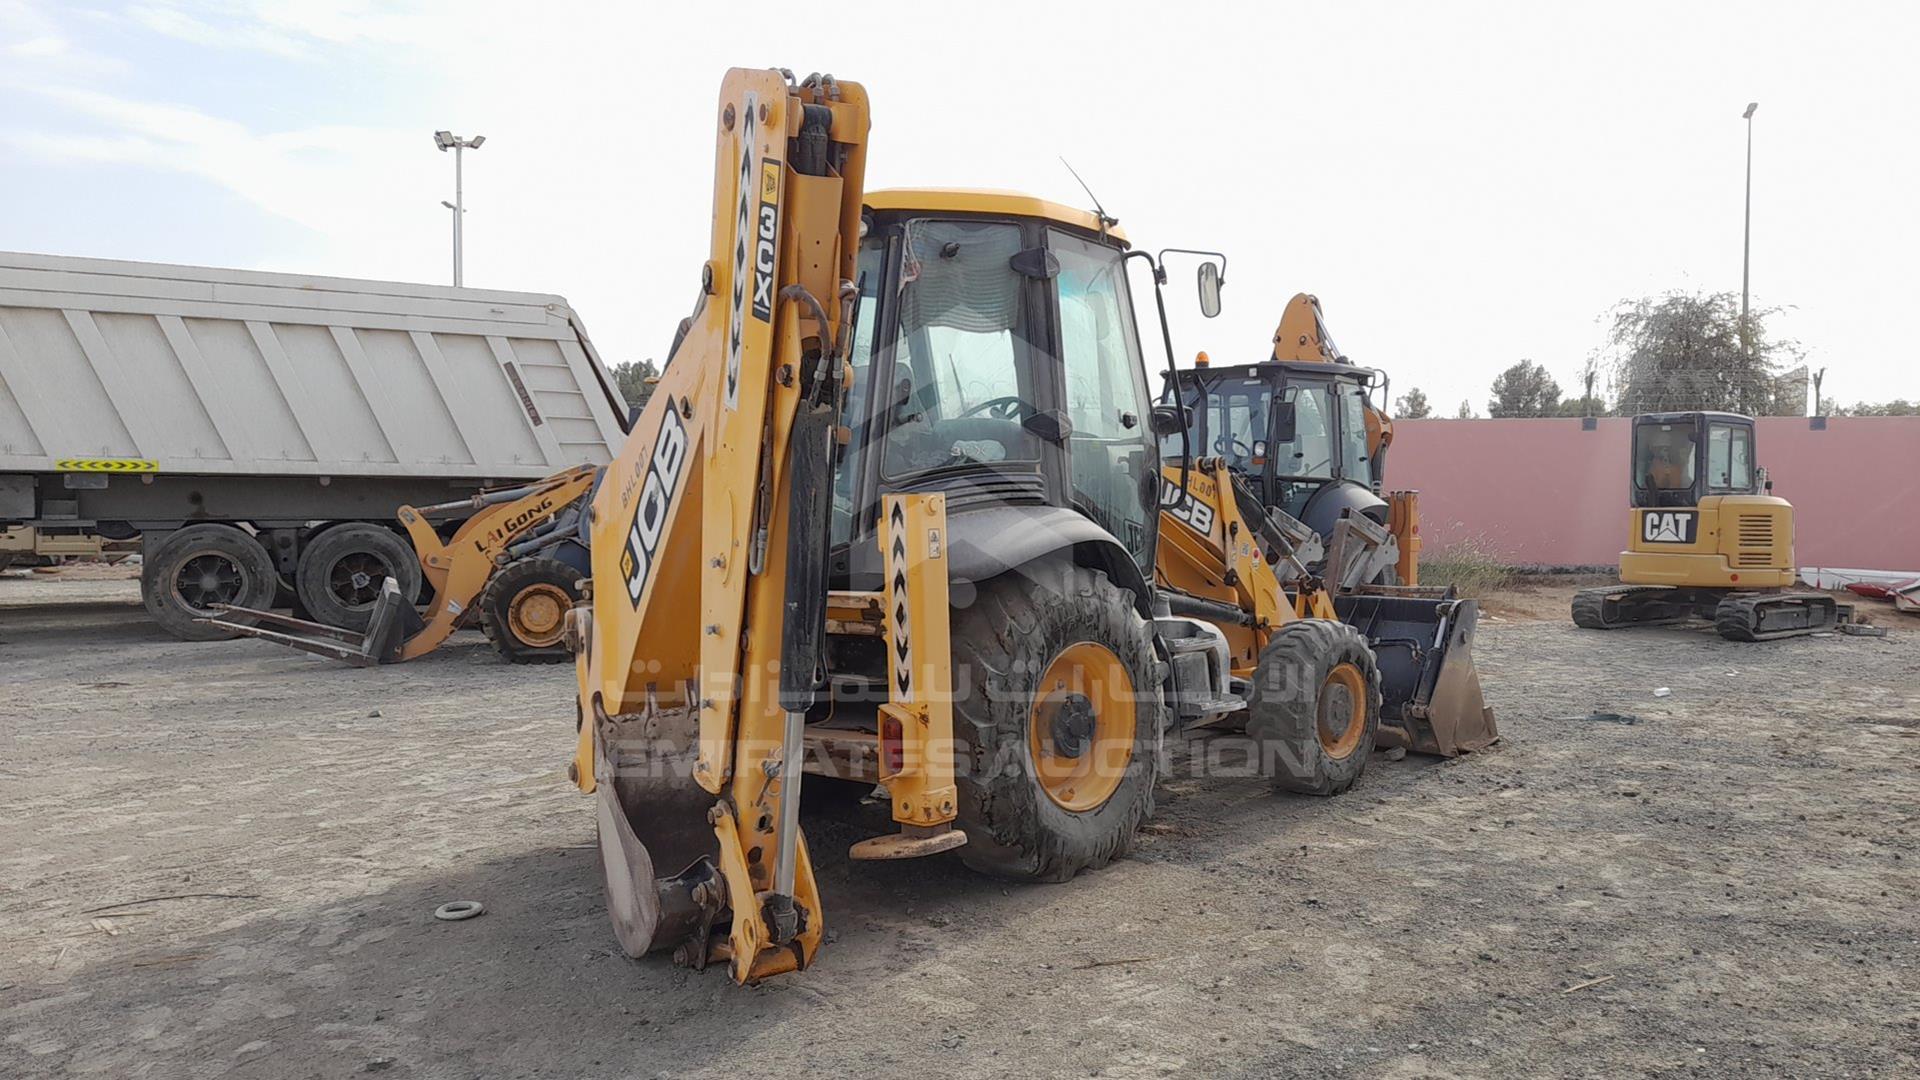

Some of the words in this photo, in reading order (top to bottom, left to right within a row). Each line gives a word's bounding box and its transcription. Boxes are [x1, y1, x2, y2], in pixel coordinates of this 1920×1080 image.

[753, 206, 775, 307] 3CX
[629, 409, 686, 599] JCB
[1645, 512, 1692, 542] CAT
